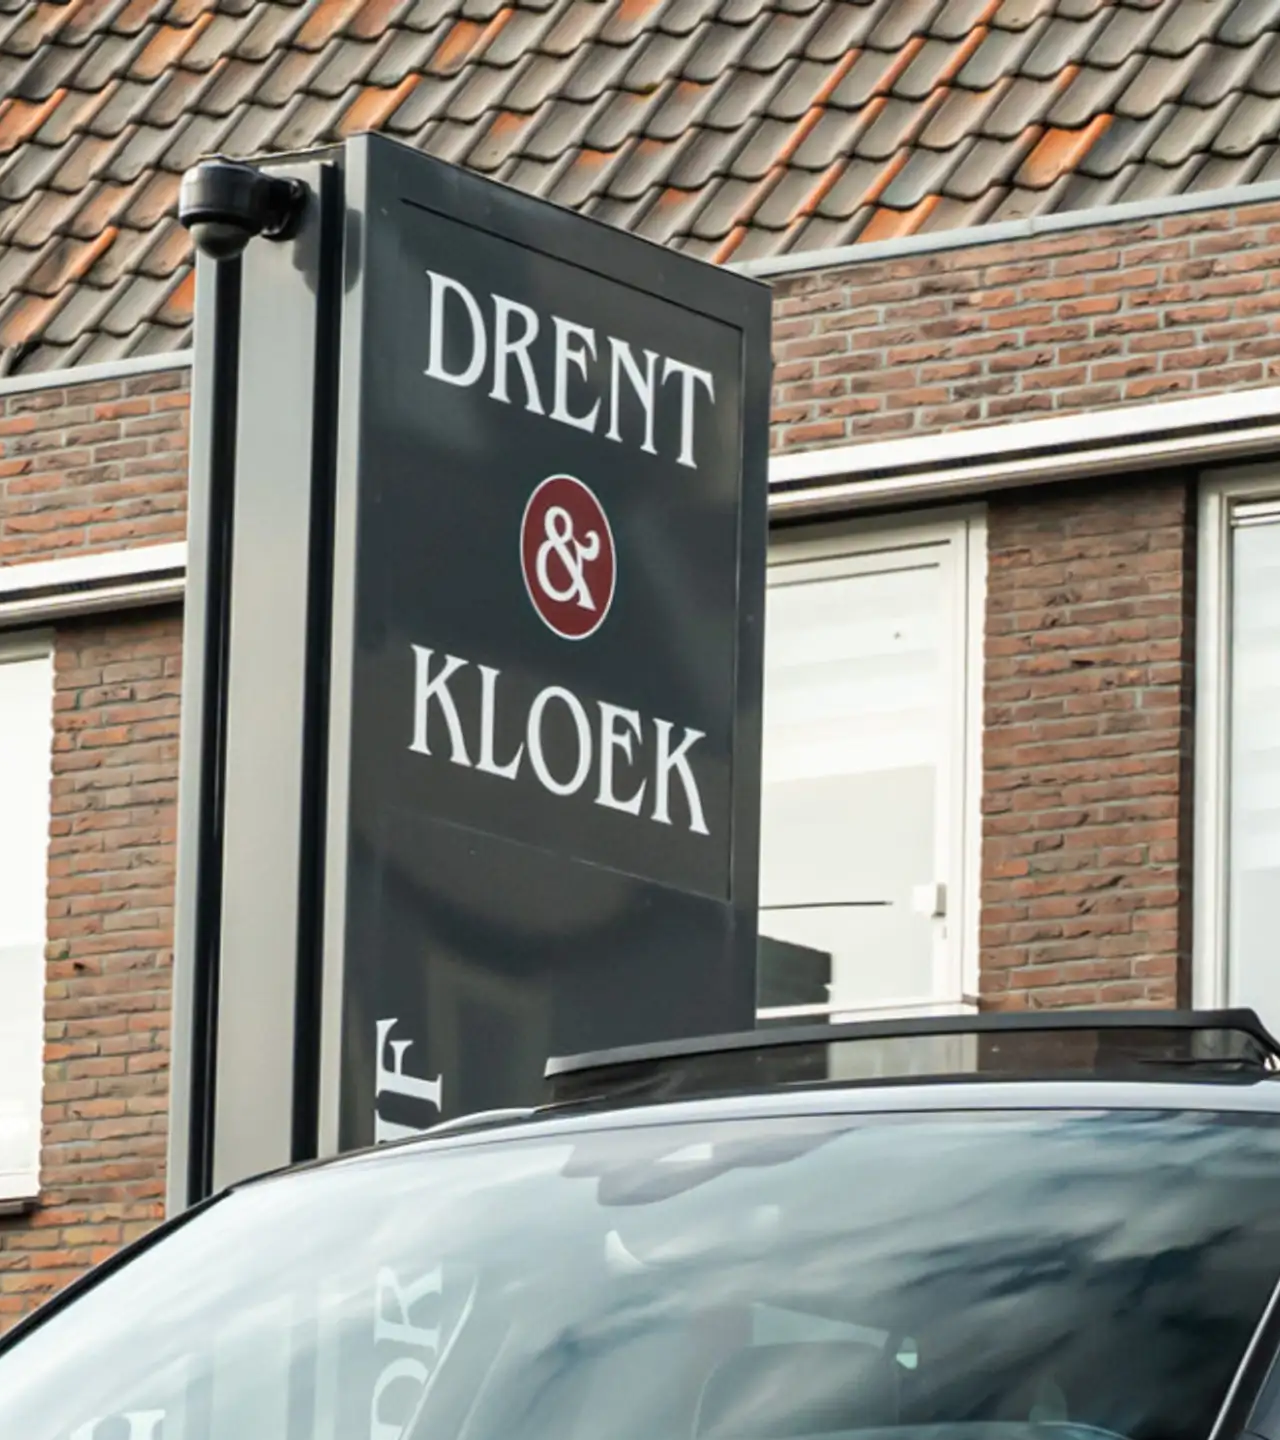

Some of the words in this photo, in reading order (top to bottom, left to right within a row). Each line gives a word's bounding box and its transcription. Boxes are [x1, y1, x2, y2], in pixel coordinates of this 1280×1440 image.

[423, 269, 715, 469] DRENT
[535, 505, 600, 611] &
[407, 643, 711, 836] KLOEK
